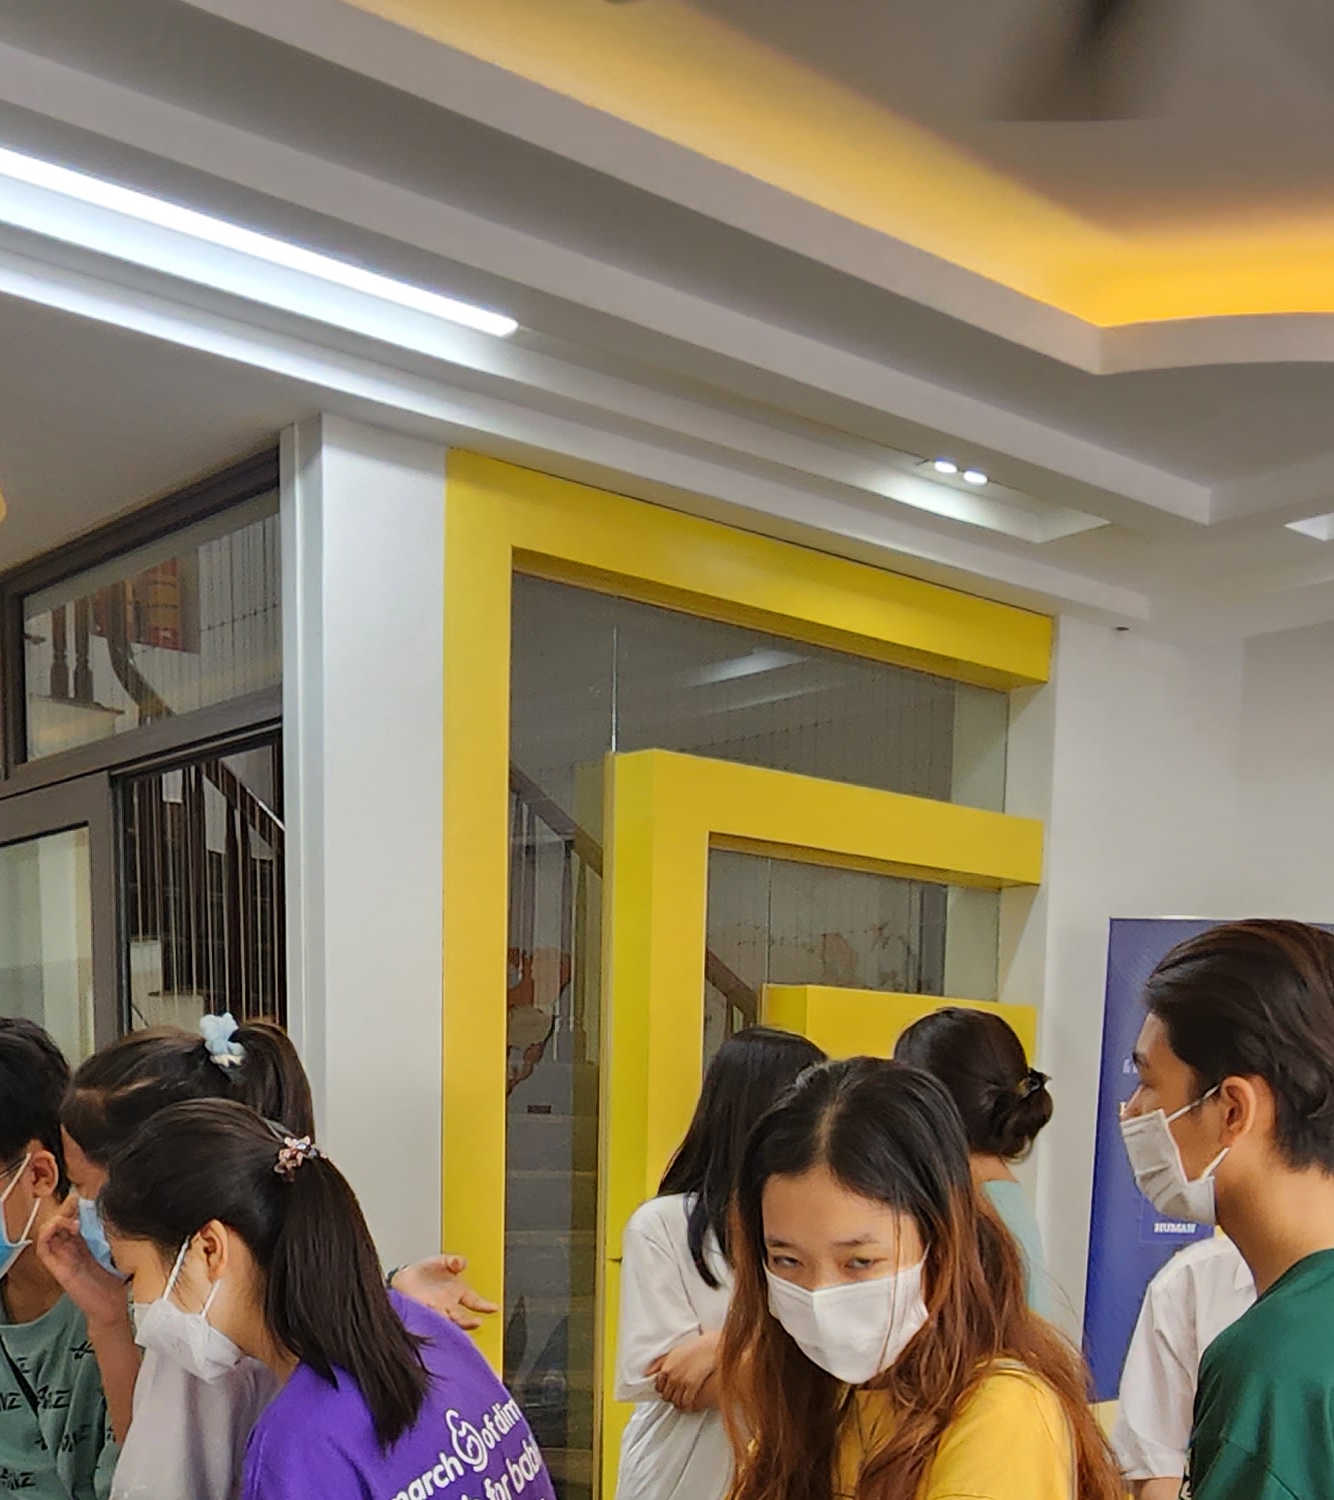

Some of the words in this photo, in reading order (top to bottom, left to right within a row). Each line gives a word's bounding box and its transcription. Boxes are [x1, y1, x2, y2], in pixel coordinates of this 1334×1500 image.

[1153, 1223, 1198, 1234] HUMAN
[482, 1413, 501, 1450] of
[494, 1399, 523, 1435] dim
